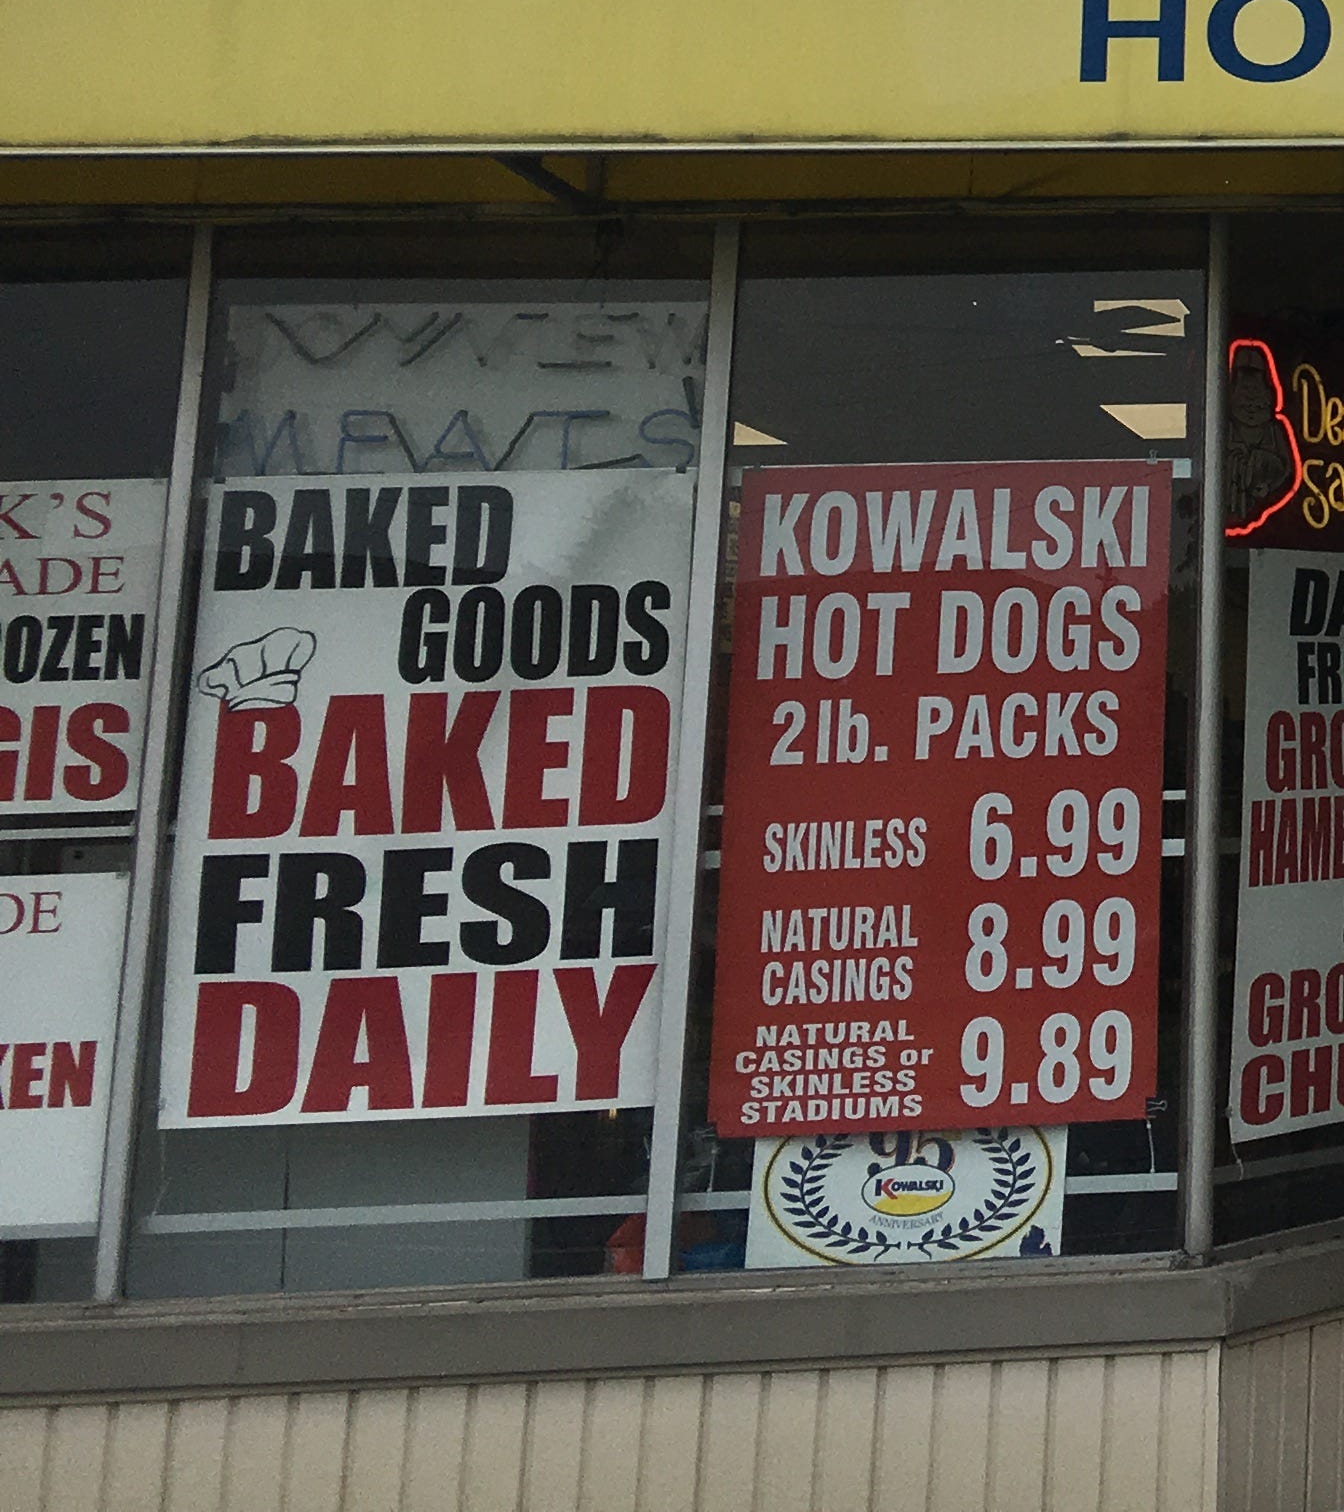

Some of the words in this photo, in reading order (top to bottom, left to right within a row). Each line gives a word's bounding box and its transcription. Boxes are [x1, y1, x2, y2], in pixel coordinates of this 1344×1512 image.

[214, 485, 514, 591] BAKED
[760, 486, 1150, 578] KOWALSKI
[399, 580, 672, 684] GOODS
[757, 592, 910, 681] HOT
[937, 585, 1142, 675] DOGS
[207, 685, 672, 840] BAKED
[915, 690, 1120, 760] PACKS
[763, 817, 927, 873] SKINLESS
[969, 788, 1141, 880] 6.99
[194, 838, 659, 976] FRESH
[761, 904, 918, 953] NATURAL
[761, 956, 914, 1006] CASINGS
[964, 896, 1137, 992] 8.99
[0, 1040, 98, 1110] EN
[187, 963, 659, 1118] DAILY
[735, 1045, 886, 1074] CASINGS
[900, 1043, 934, 1067] or
[960, 1009, 1133, 1108] 9.89
[756, 1019, 915, 1047] NATURAL
[740, 1094, 923, 1125] STADIUMS
[750, 1069, 916, 1098] SKINLESS
[868, 1211, 944, 1230] ANNIVERSARY
[874, 1178, 944, 1200] KOWALSKI
